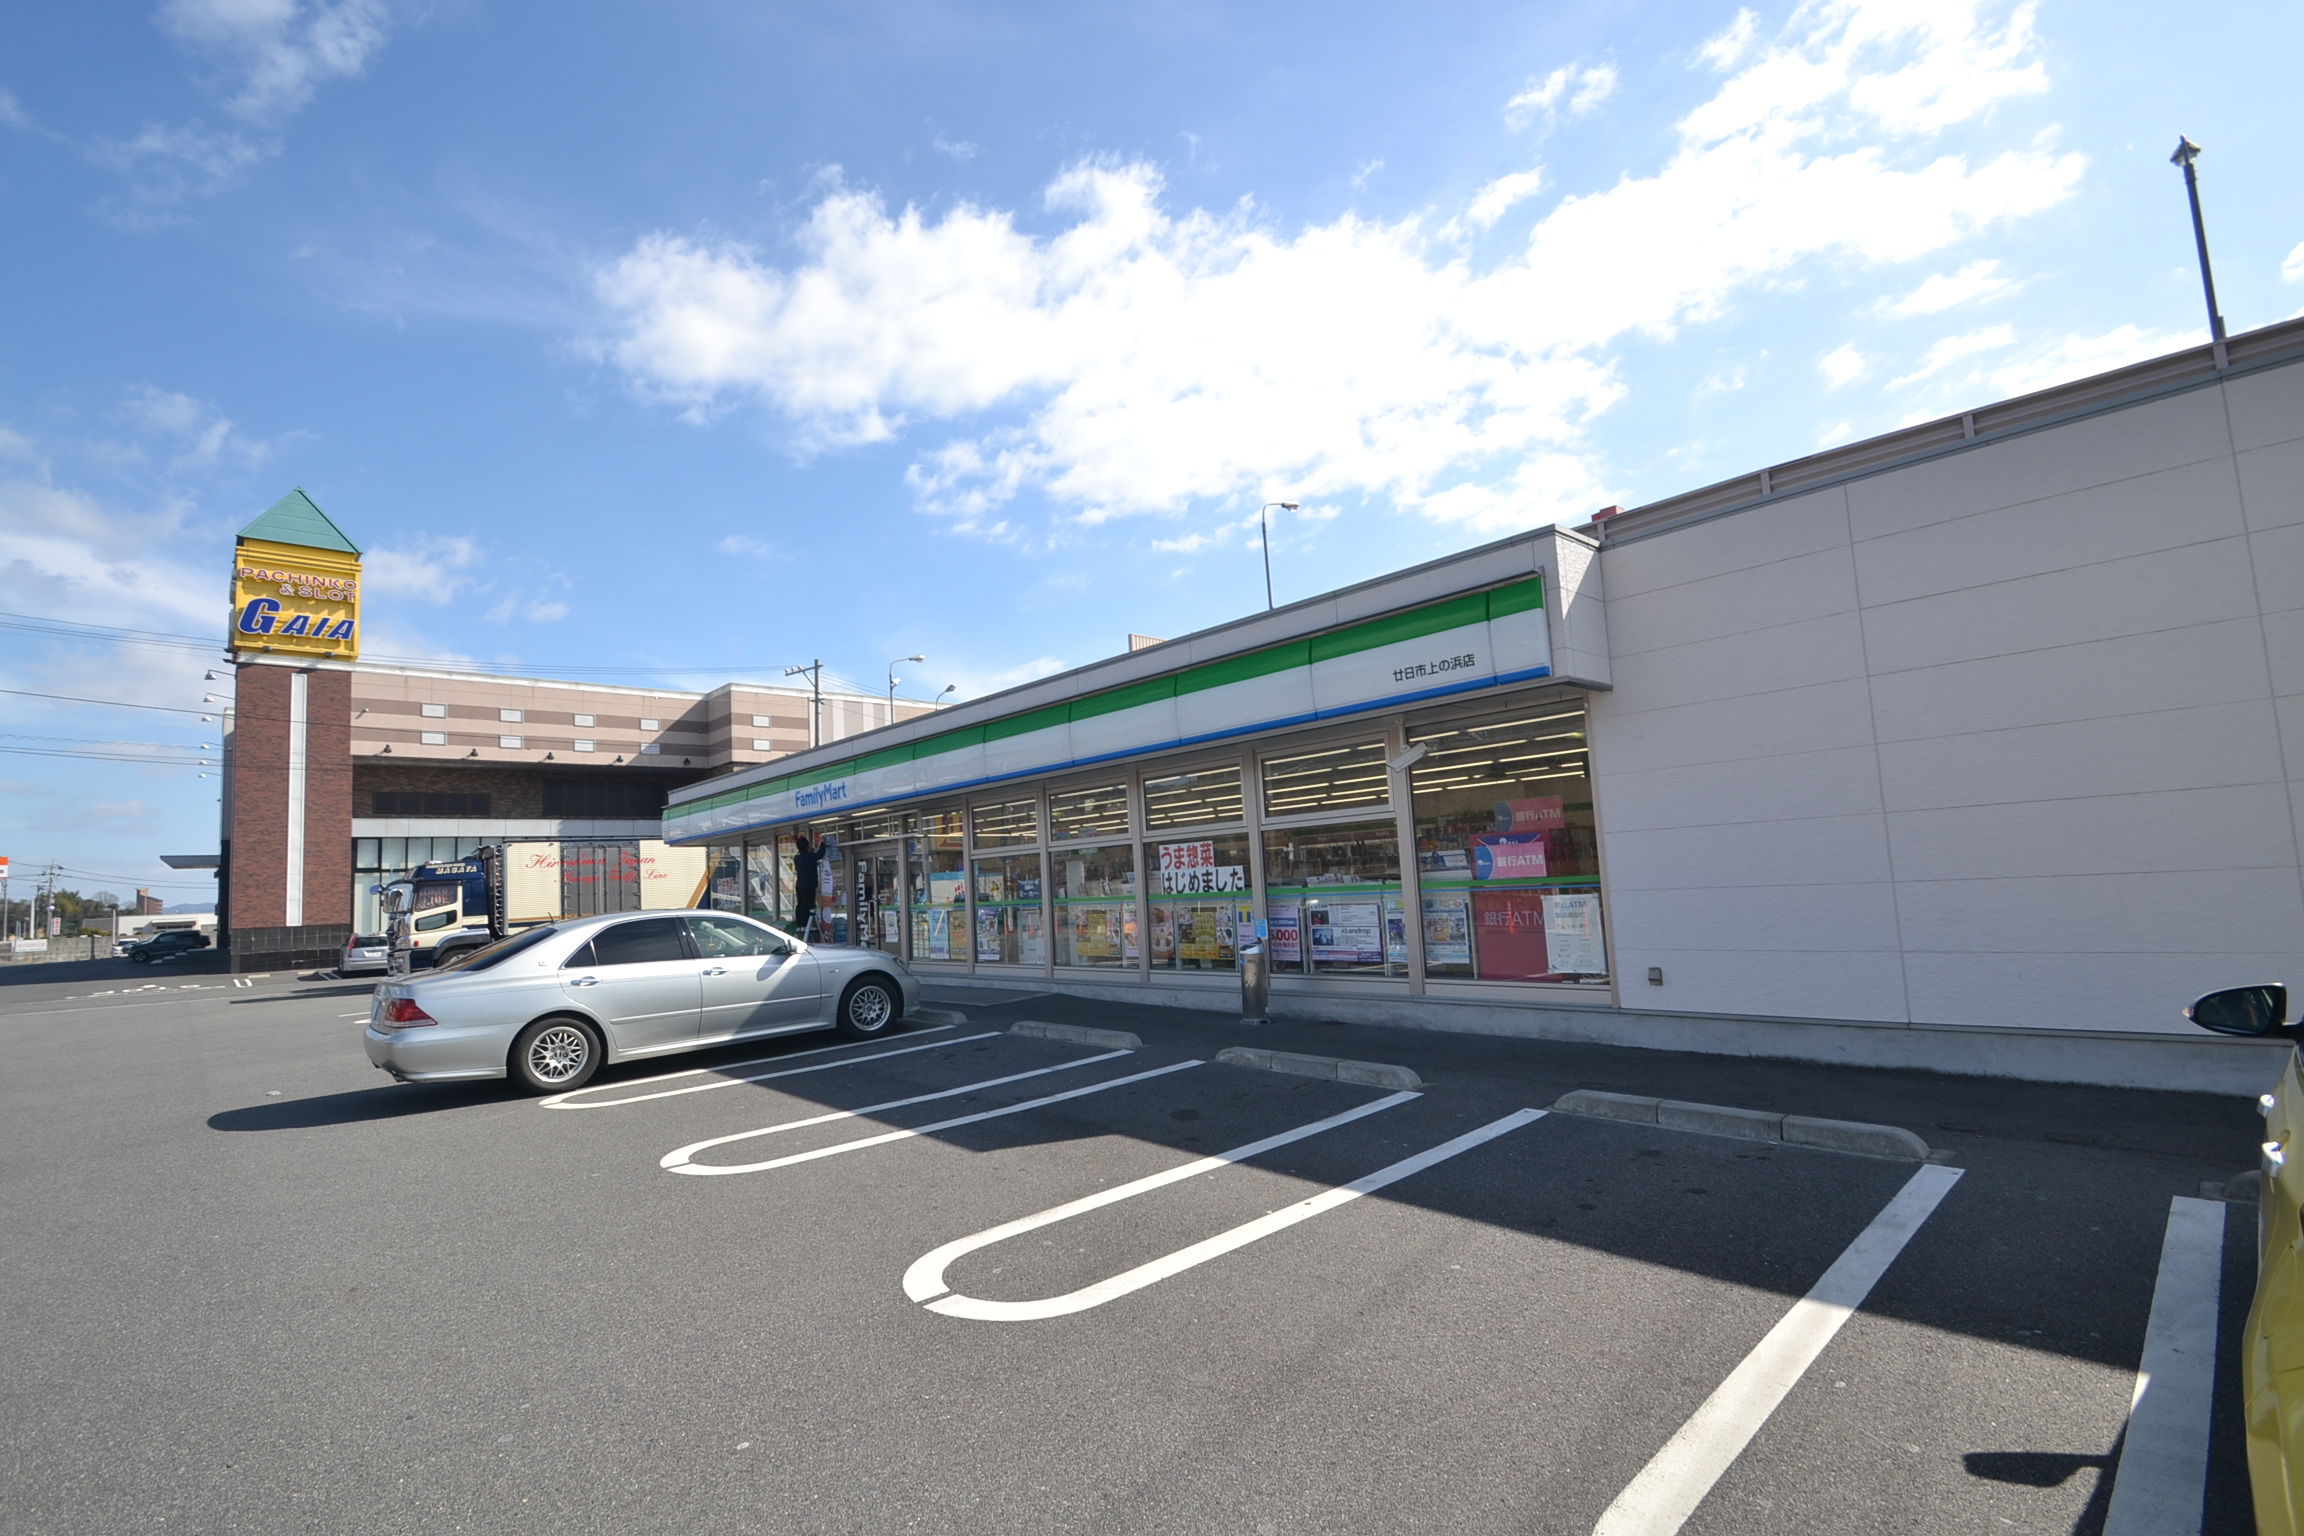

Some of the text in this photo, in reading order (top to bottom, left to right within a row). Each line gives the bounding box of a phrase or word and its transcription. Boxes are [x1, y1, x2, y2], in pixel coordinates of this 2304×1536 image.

[240, 567, 357, 591] PACHINKO
[279, 584, 356, 602] & SLOT
[238, 598, 356, 640] GAIA
[1393, 653, 1475, 682] 廿日市上の浜店
[795, 781, 847, 808] FamilyMart
[1516, 808, 1561, 822] 銀行ATM
[1161, 842, 1213, 870] うま惣菜
[1497, 854, 1543, 867] 銀行ATM
[644, 869, 668, 880] Line
[1162, 867, 1244, 895] はじめました
